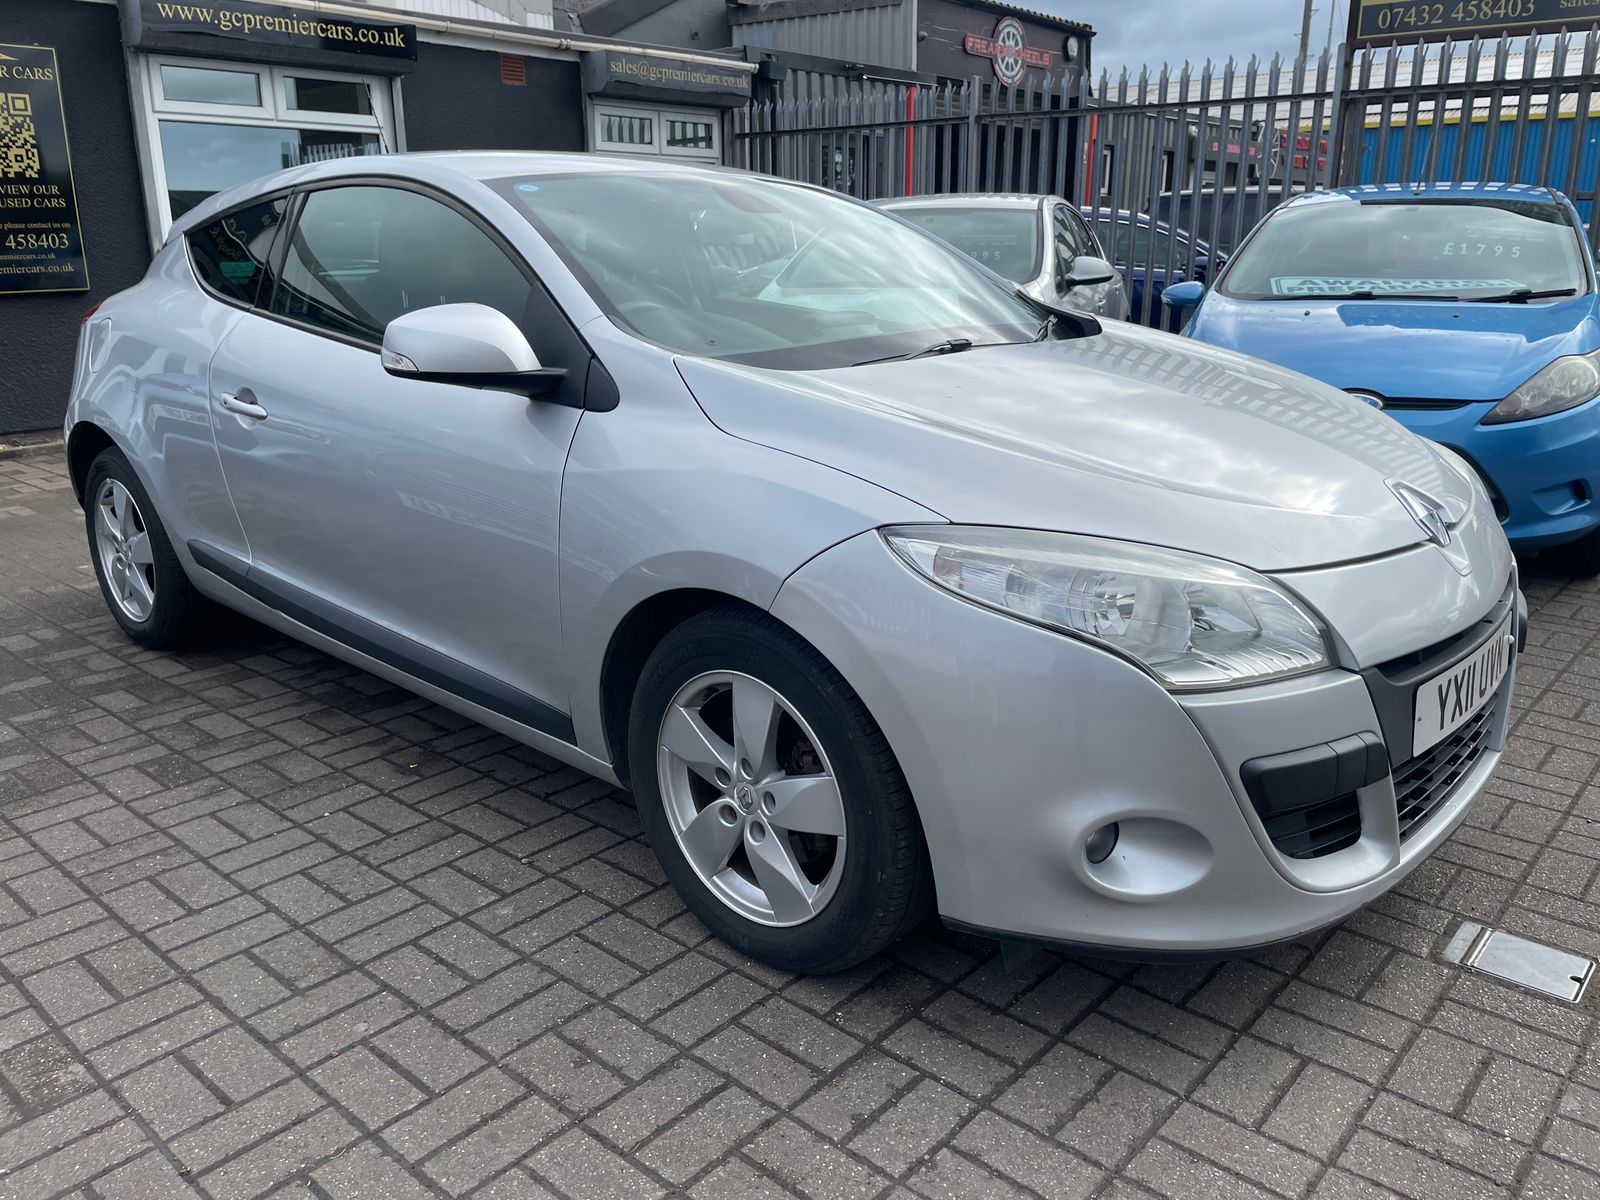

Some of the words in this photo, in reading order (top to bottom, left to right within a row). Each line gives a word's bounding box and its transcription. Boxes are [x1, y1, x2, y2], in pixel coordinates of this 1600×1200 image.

[1377, 4, 1444, 29] 07432
[1450, 0, 1536, 22] 458403
[156, 2, 406, 48] www.gcpremiercars.co.uk
[12, 66, 54, 80] CARS
[609, 58, 749, 89] sales@gcpremiercars.co.uk
[0, 184, 30, 195] VIEW
[33, 184, 61, 195] OUR
[0, 197, 31, 208] USED
[34, 197, 67, 208] CARS
[4, 221, 26, 231] please
[5, 233, 69, 250] 458403
[1437, 660, 1477, 731] YX11
